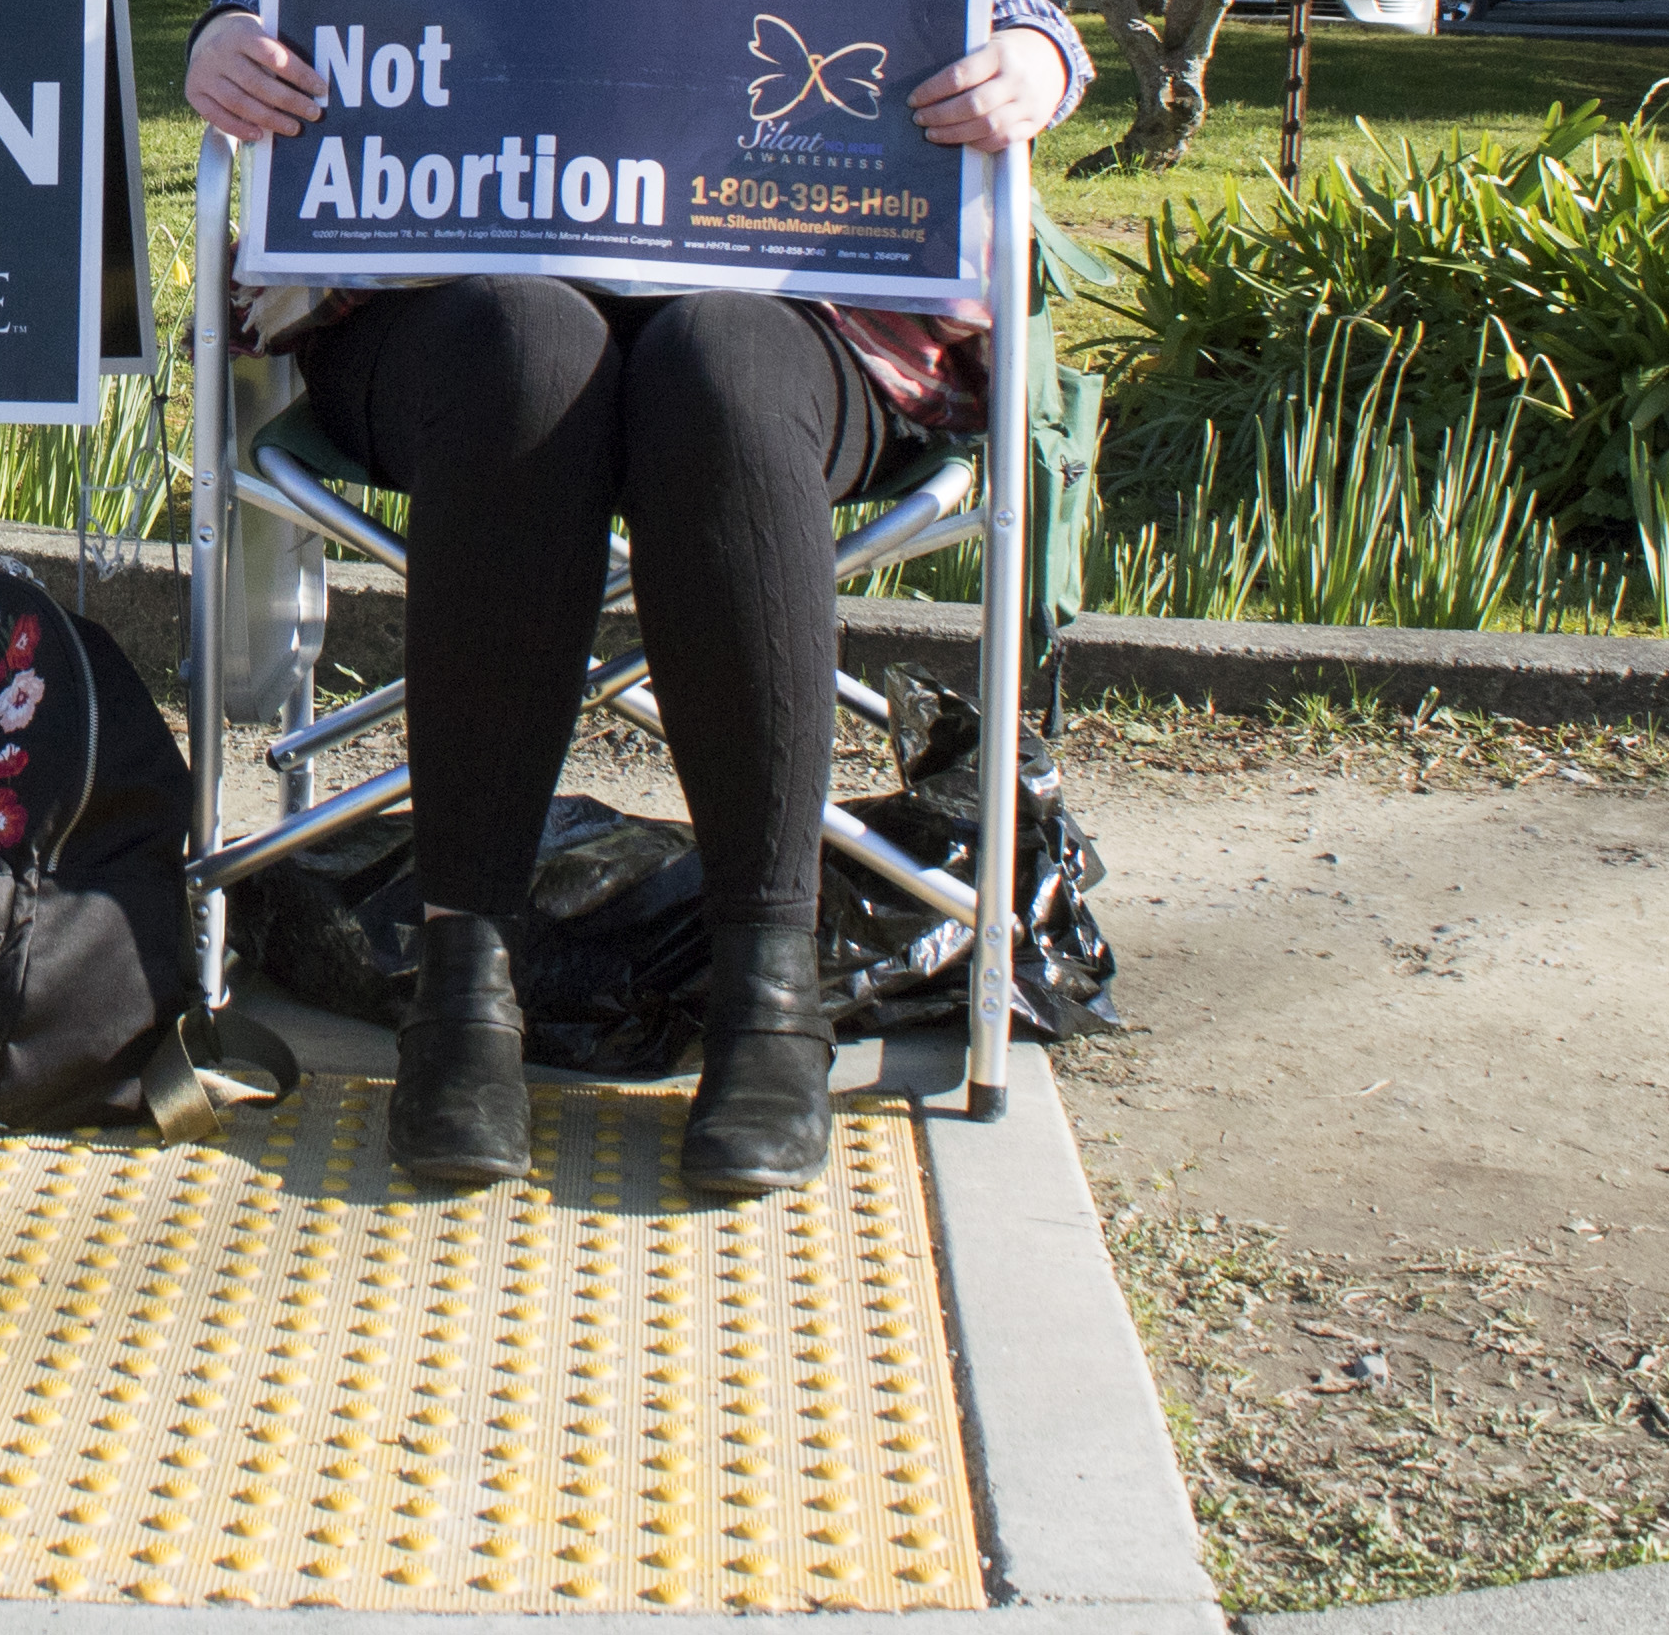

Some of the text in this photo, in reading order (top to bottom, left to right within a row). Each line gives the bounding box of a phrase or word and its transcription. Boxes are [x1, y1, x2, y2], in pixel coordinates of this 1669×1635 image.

[313, 25, 451, 108] Not
[737, 120, 824, 153] Silent
[299, 134, 666, 226] Abortion
[744, 151, 885, 171] AWARENESS
[691, 176, 929, 223] 1-800-395-Help
[690, 214, 926, 243] www.SilentNoMoreAwareness.org
